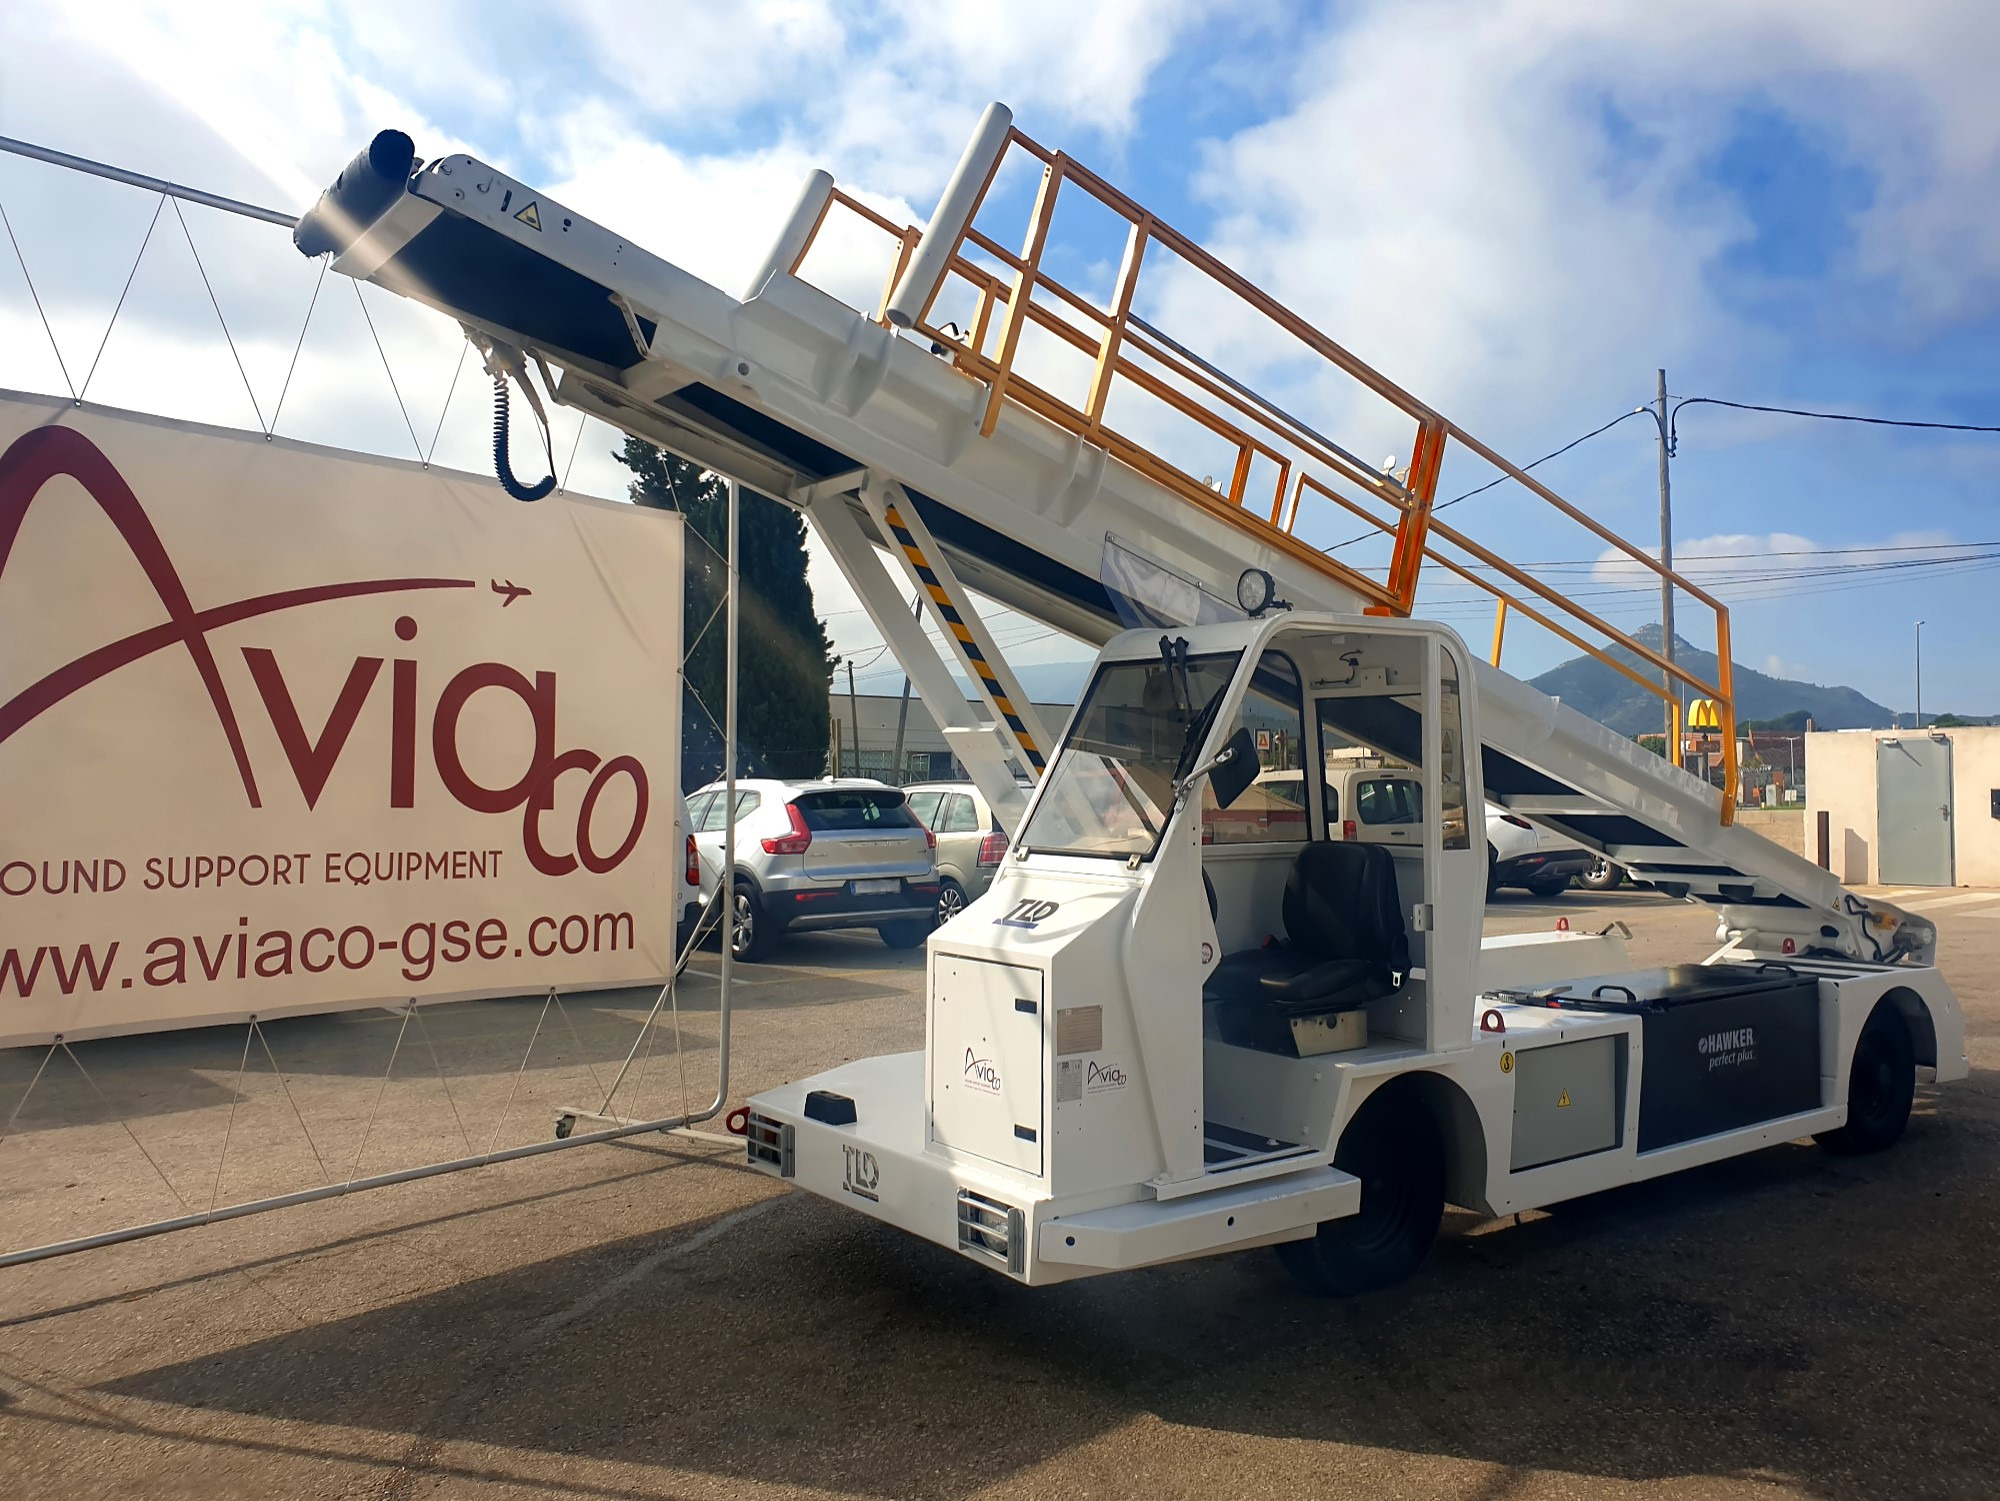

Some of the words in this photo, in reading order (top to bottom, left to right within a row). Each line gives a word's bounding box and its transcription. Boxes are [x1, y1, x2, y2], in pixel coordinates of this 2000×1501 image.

[143, 853, 311, 890] SUPPORT
[325, 850, 503, 886] EQUIPMENT
[1708, 1027, 1754, 1054] HAWKER
[1708, 1051, 1736, 1072] perfect
[1737, 1048, 1753, 1067] plus
